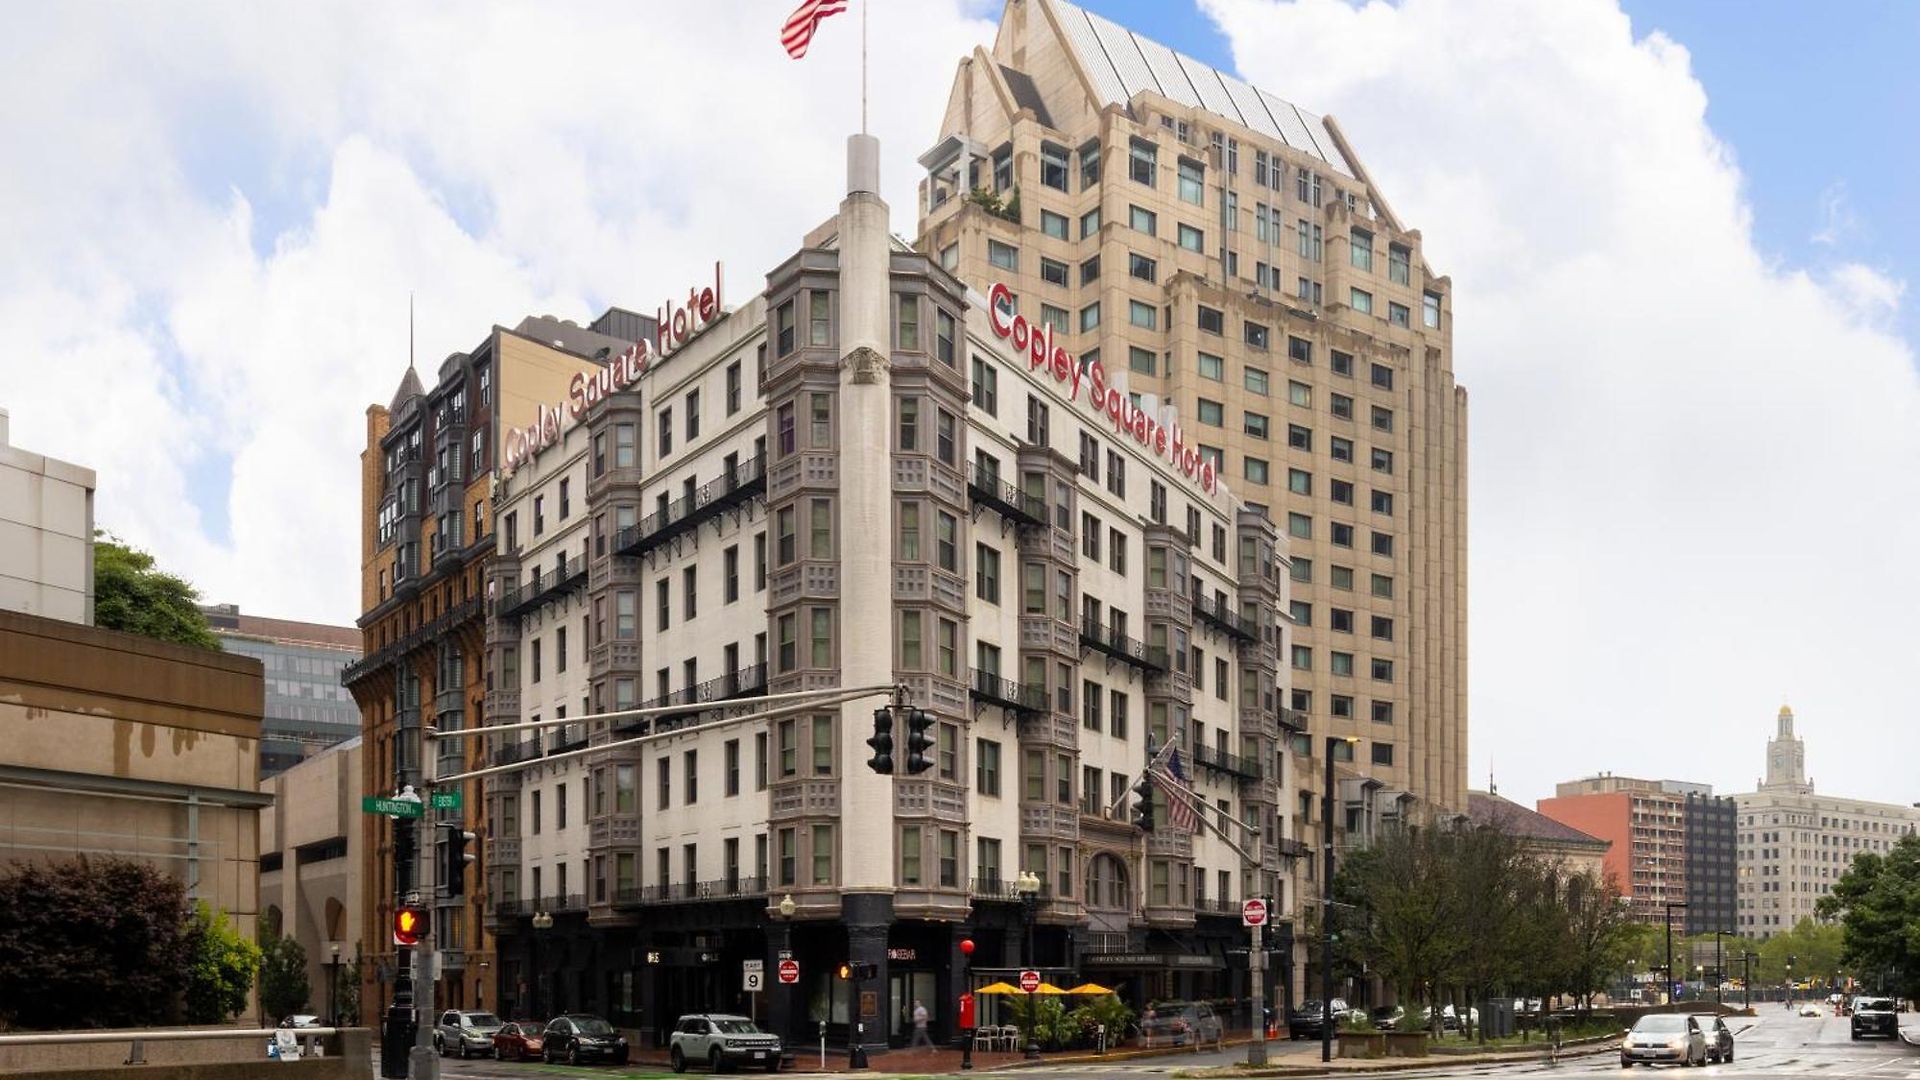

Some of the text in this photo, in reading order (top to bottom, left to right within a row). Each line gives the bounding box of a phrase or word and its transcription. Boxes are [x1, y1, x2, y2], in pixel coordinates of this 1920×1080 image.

[505, 261, 721, 470] Copley Square Hotel
[988, 282, 1217, 497] Copley Square Hotel
[375, 800, 412, 814] HUNTINGTON
[749, 974, 758, 988] 9
